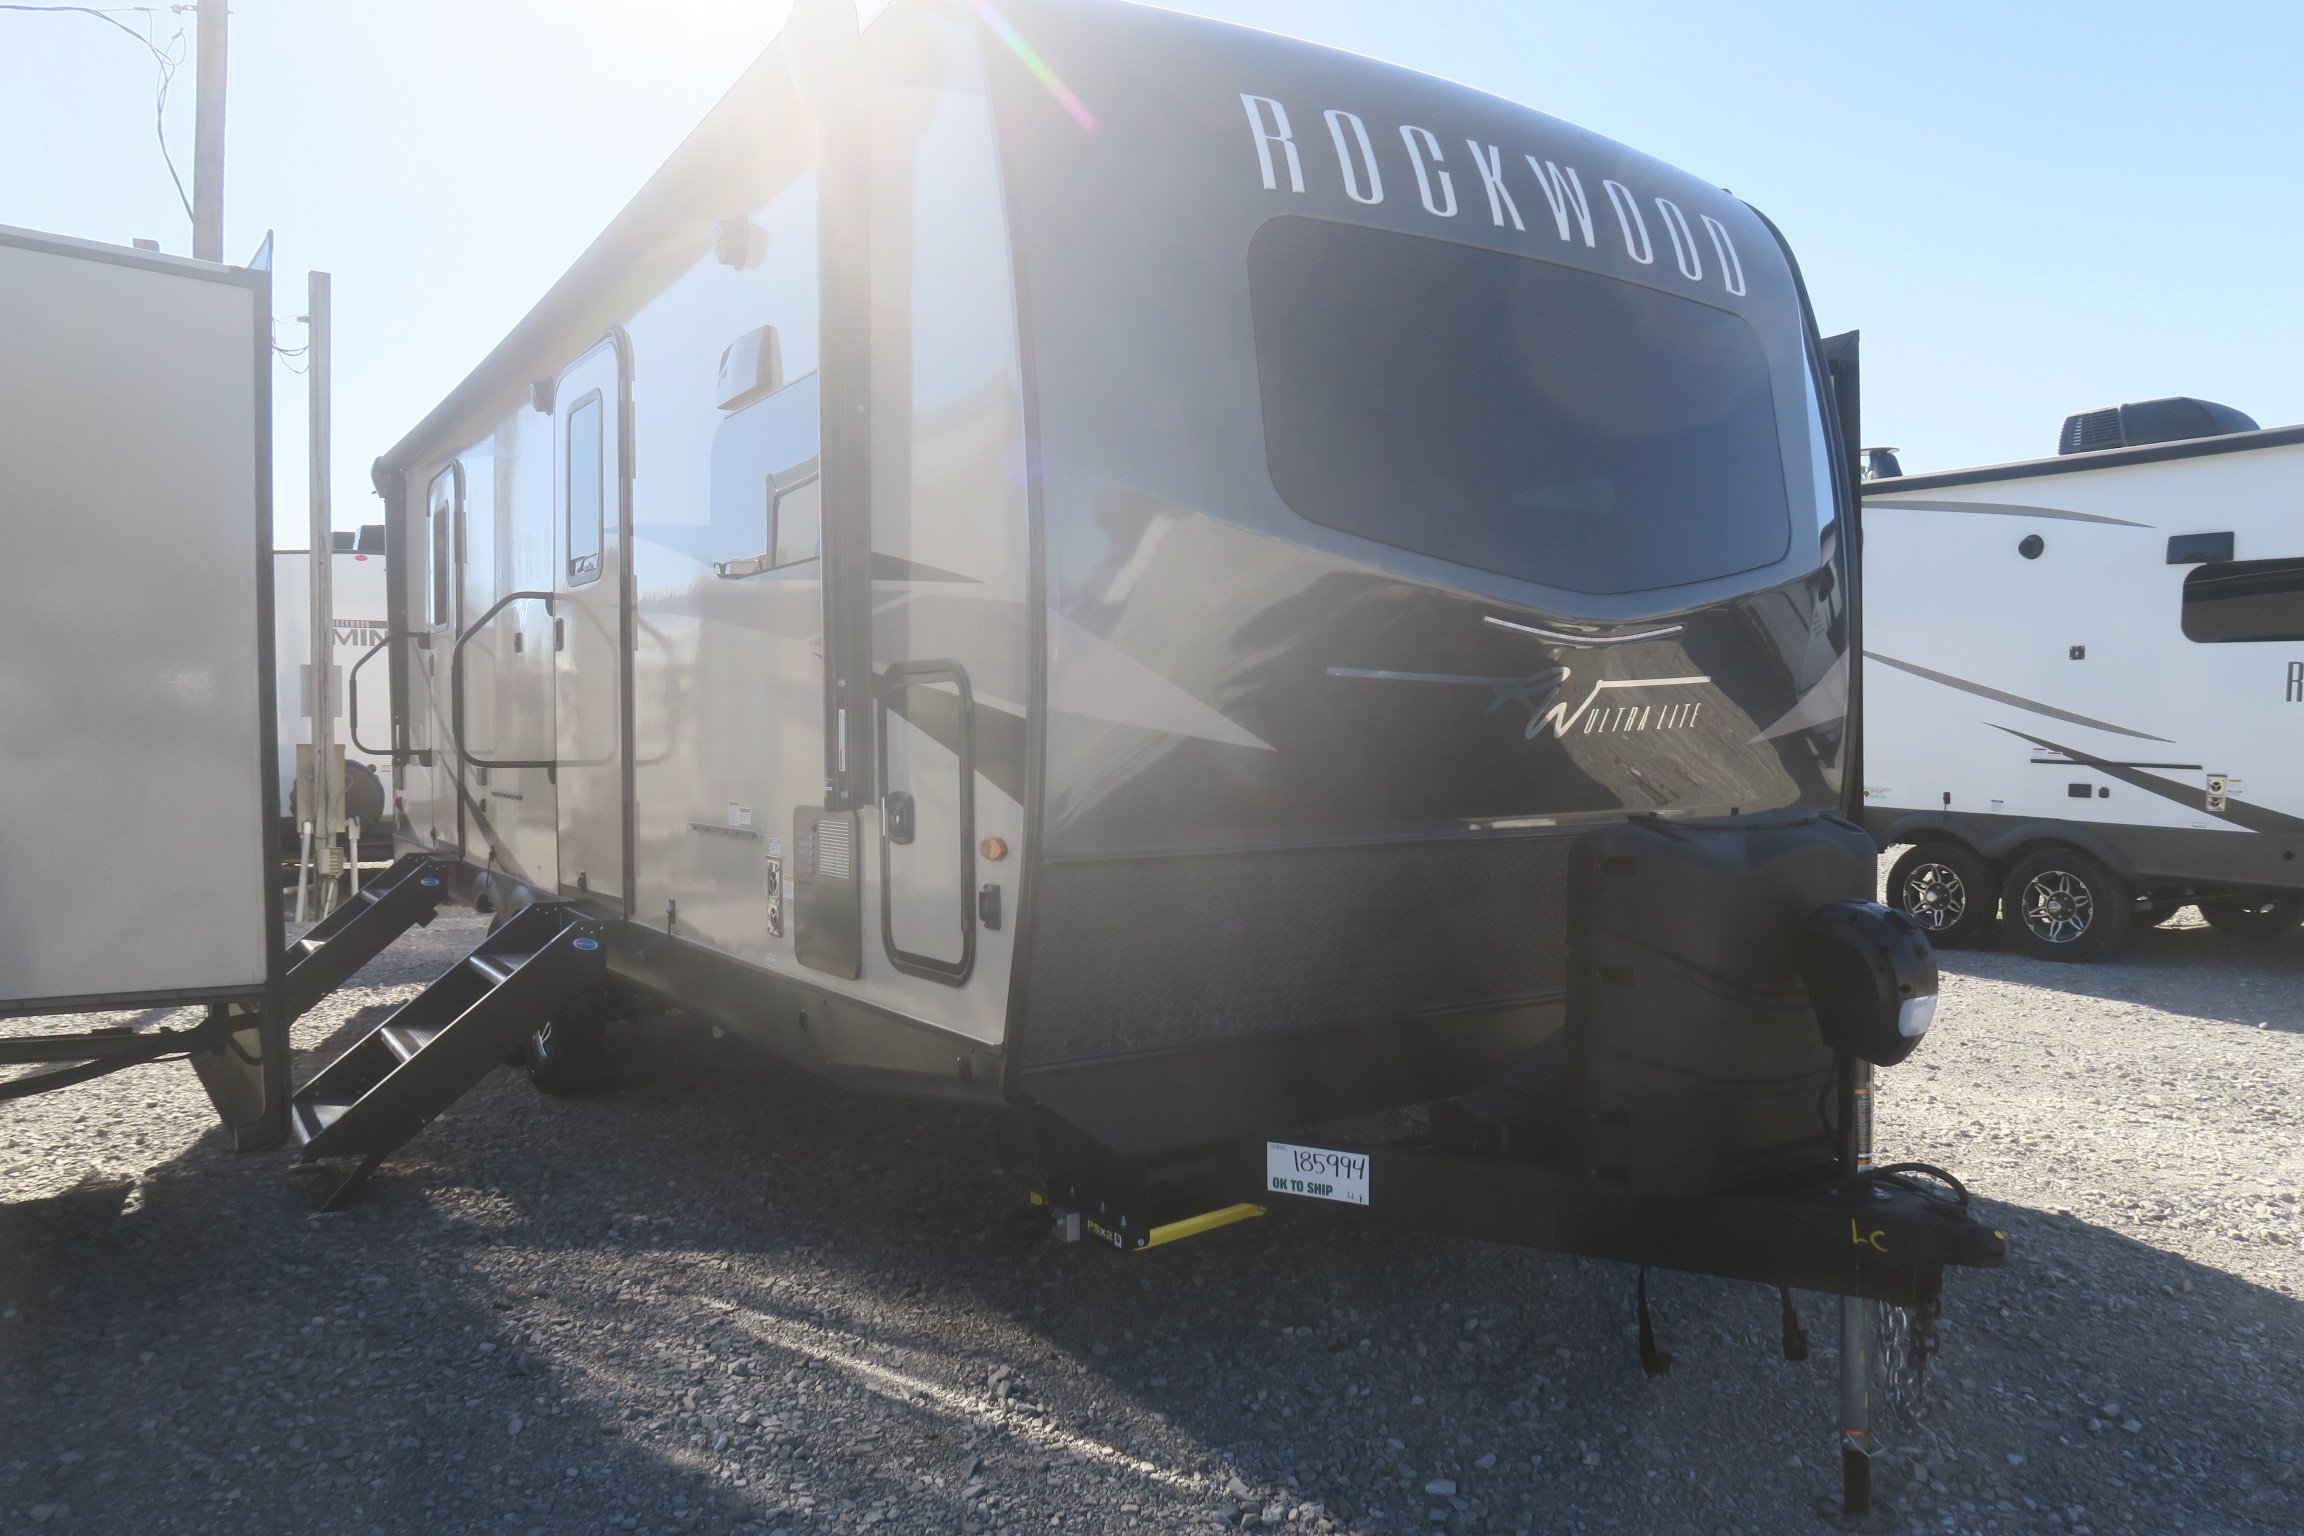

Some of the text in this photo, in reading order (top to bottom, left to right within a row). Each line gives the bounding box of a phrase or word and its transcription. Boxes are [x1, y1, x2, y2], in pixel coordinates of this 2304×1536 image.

[1240, 93, 1746, 296] ROCKWOOD
[1583, 702, 1702, 734] ULTRA LITE
[1293, 1150, 1365, 1180] 185994
[1272, 1176, 1333, 1196] OK TO SHIP
